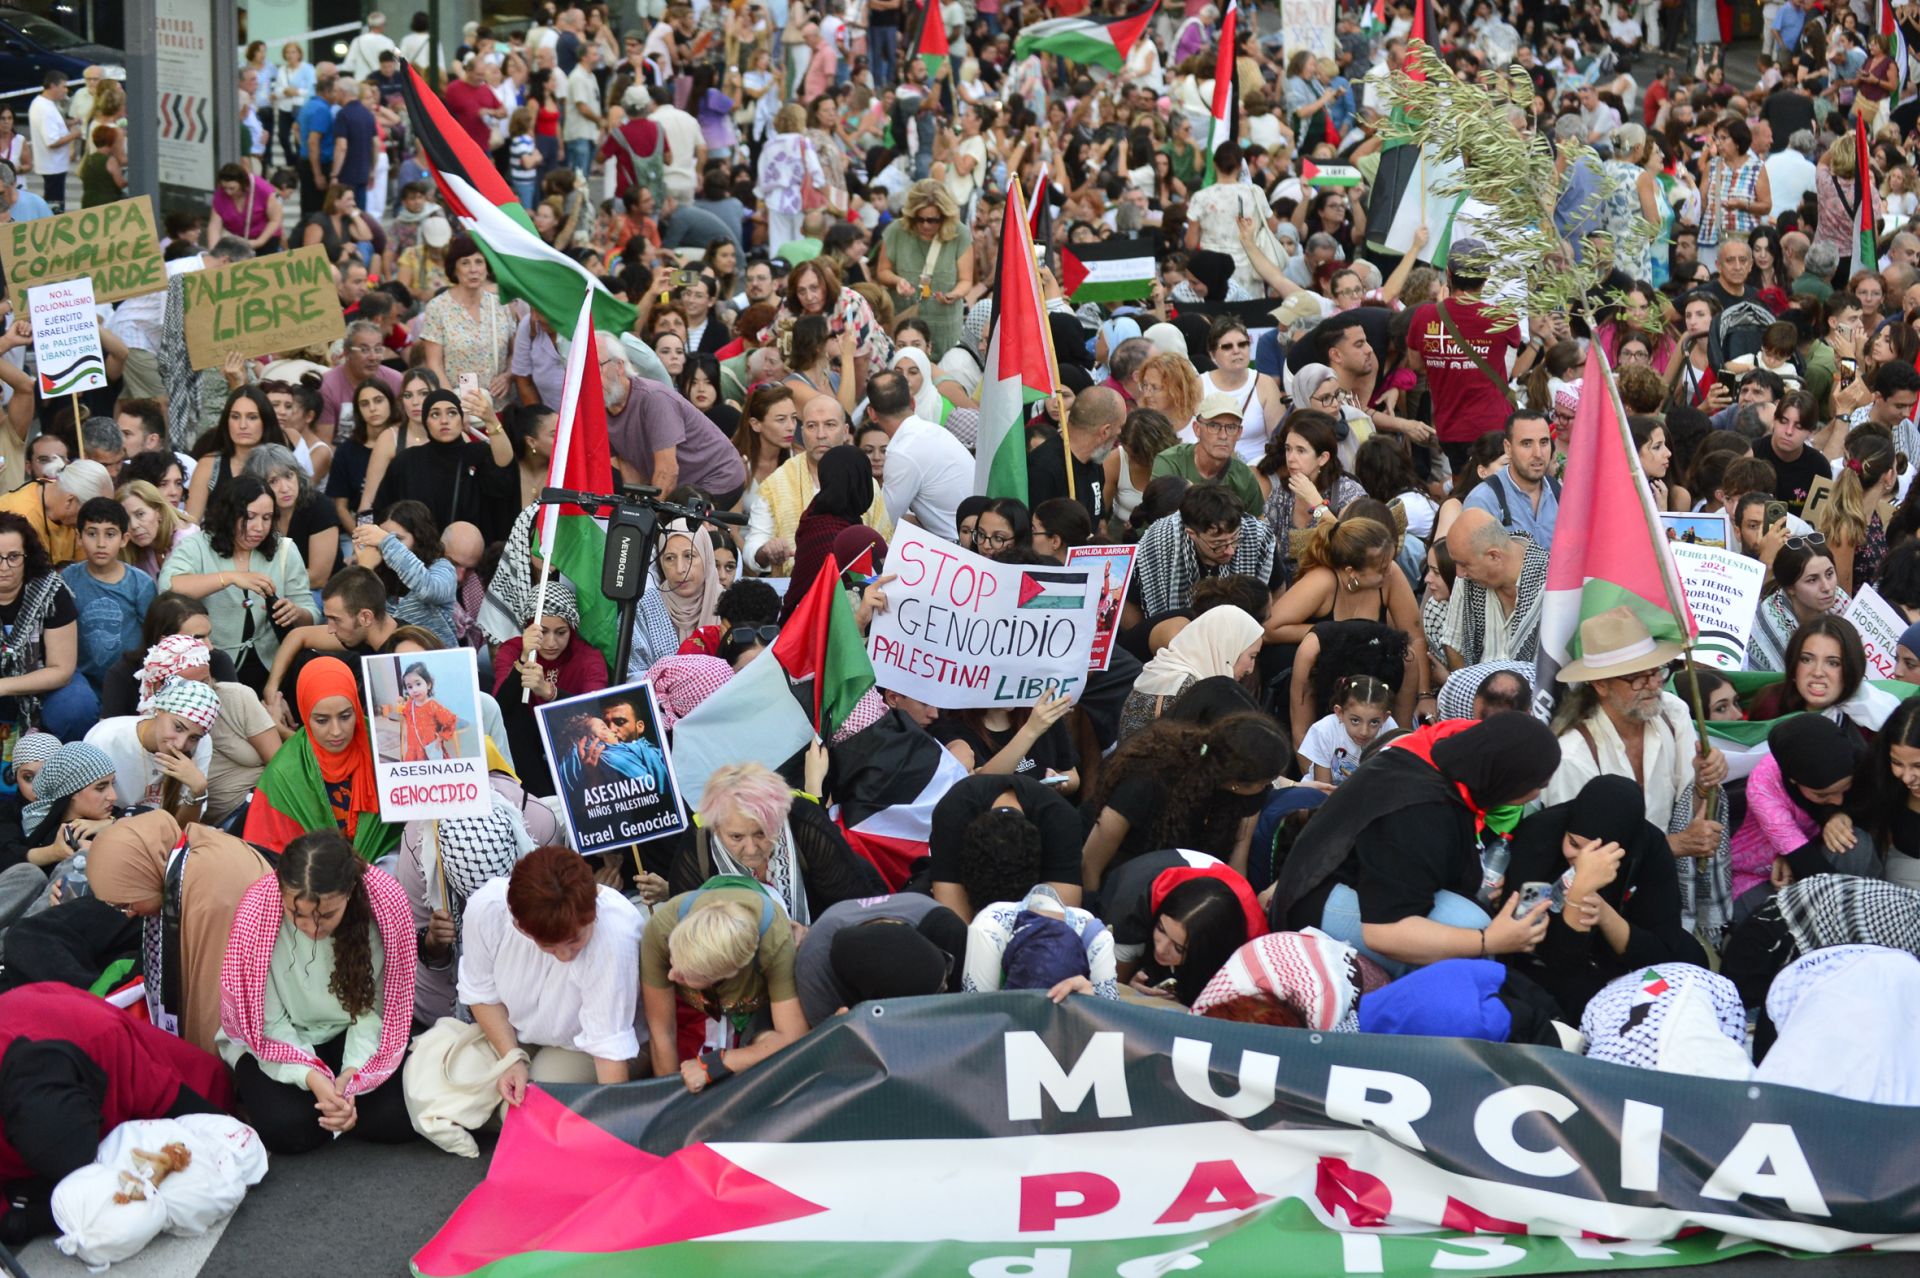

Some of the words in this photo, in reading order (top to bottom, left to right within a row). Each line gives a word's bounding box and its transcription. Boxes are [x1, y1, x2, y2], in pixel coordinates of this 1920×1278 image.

[12, 202, 147, 257] EUROPA
[49, 290, 62, 299] NO
[63, 289, 73, 297] AL
[183, 249, 334, 314] PALESTINA
[69, 321, 95, 332] FUERA
[213, 287, 325, 343] LIBRE
[40, 342, 49, 351] de
[53, 333, 95, 347] PALESTINA
[79, 344, 98, 354] SIRIA
[1446, 343, 1490, 355] Mona
[616, 536, 631, 588] NEWBOLER
[1075, 548, 1103, 557] KHALIDA
[1104, 547, 1130, 555] JARRAR
[1674, 548, 1708, 560] TIERRA
[1710, 553, 1760, 575] PALESTINA
[899, 541, 997, 612] STOP
[1700, 560, 1726, 573] 2024
[1681, 577, 1698, 586] AS
[1701, 578, 1744, 598] TIERRAS
[897, 598, 1076, 658] GENOCIDIO
[872, 635, 991, 690] PALESTINA
[994, 675, 1079, 701] LIBRE
[389, 762, 475, 778] ASESINADA
[390, 783, 478, 806] GENOCIDIO
[584, 774, 656, 806] ASESINATO
[587, 805, 612, 819] NIÑOS
[614, 793, 660, 814] PALESTINOS
[578, 824, 615, 847] Israel
[620, 810, 680, 837] Genocida
[1004, 1031, 1832, 1217] MURCIA
